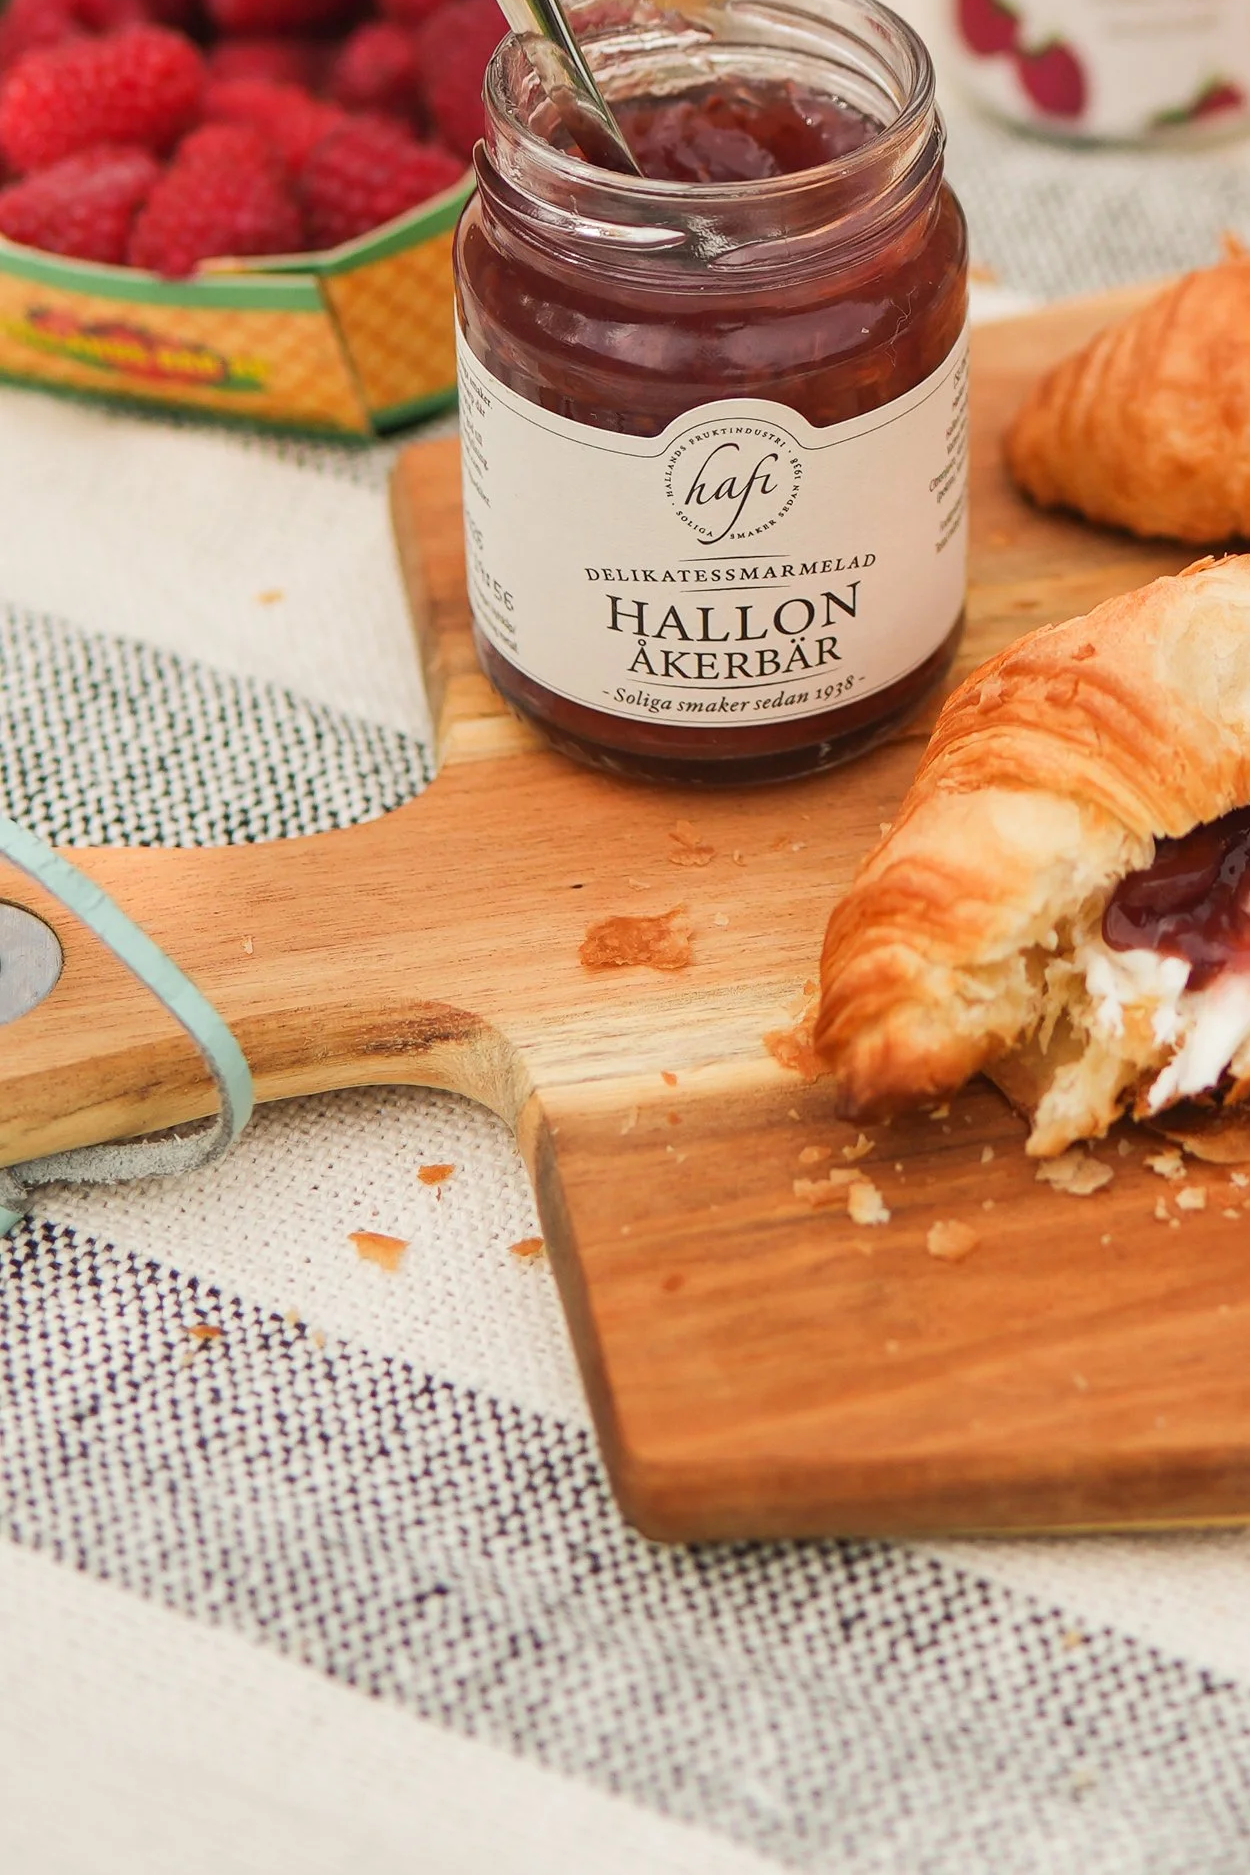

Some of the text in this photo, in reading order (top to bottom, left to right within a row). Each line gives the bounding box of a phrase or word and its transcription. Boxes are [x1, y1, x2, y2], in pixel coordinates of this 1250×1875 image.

[664, 427, 786, 498] HALLANDS FRUKTINDUSTRI
[684, 442, 779, 546] hafi
[675, 457, 803, 540] SOLIGA SMAKER SEDAN 1938
[584, 553, 877, 583] DELIKATESSMARMELAD
[606, 580, 862, 643] HALLON
[627, 635, 842, 680] ÅKERBÄR
[613, 686, 672, 714] Soliga
[676, 696, 750, 713] smaker
[753, 691, 809, 711] sedan
[815, 674, 854, 702] 1938
